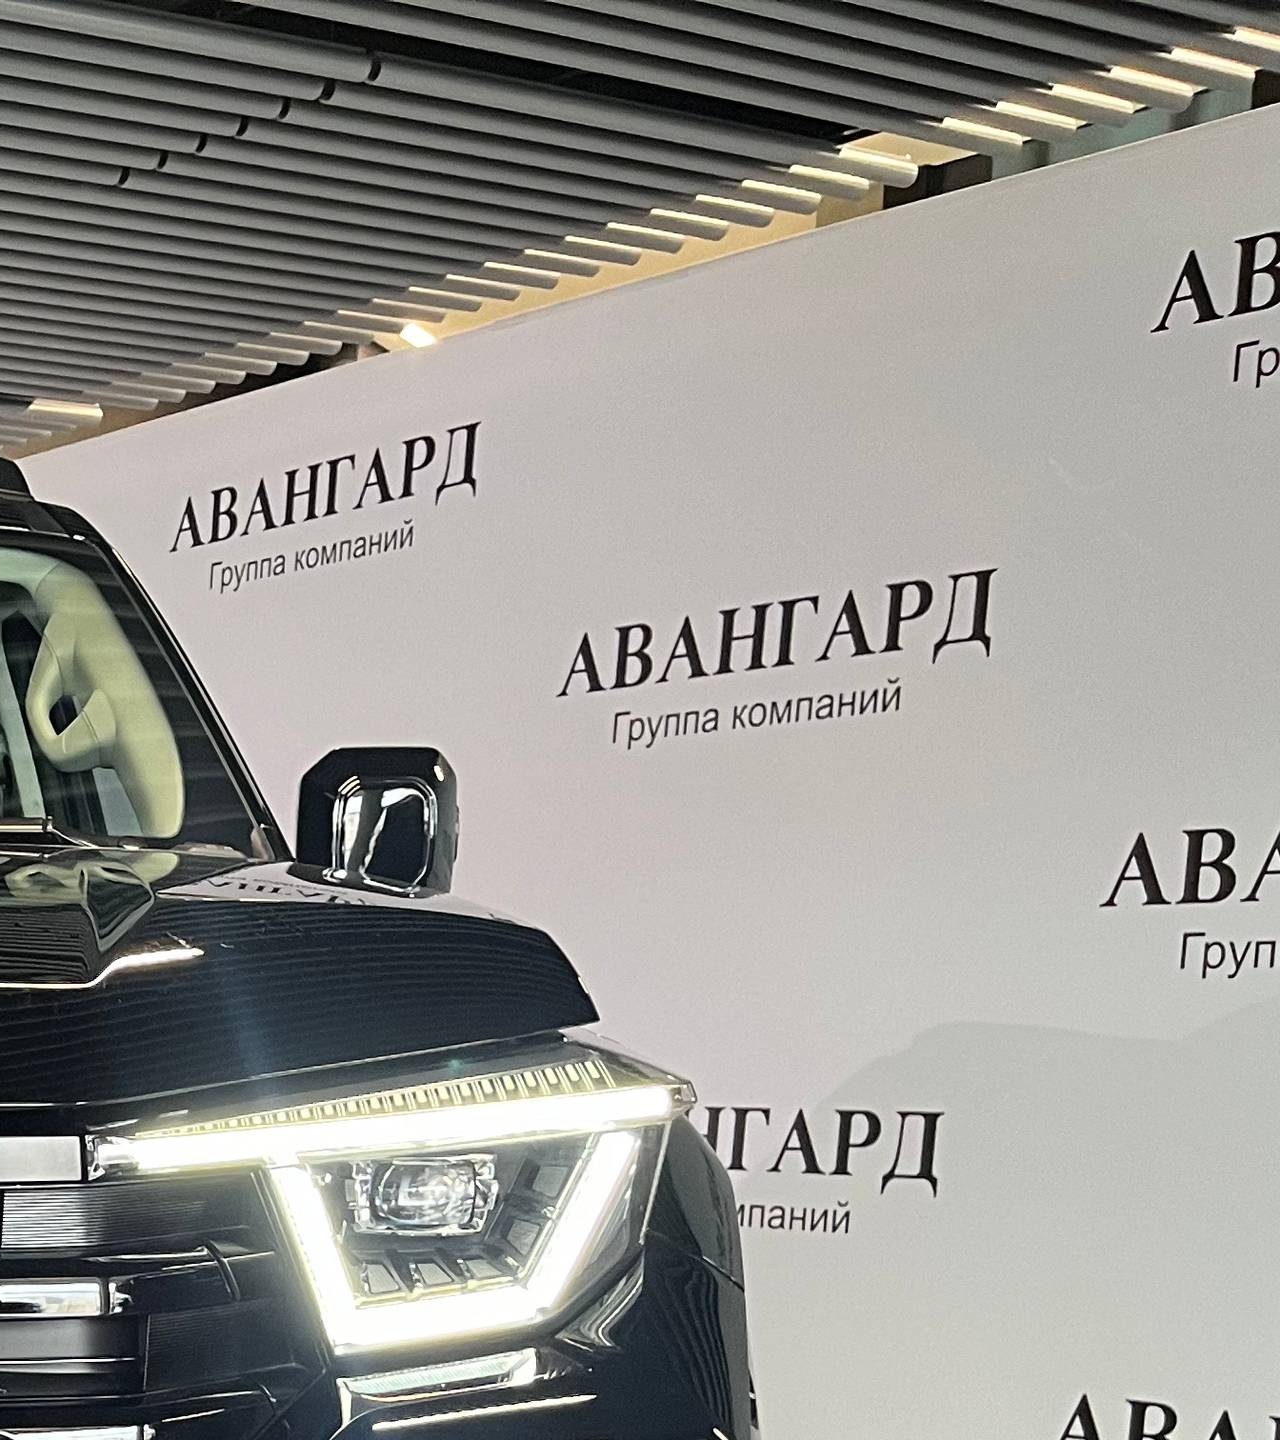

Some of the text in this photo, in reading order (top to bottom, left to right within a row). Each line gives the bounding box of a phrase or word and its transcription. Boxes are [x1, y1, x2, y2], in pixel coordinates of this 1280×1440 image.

[169, 421, 481, 553] АВАНГАРД
[209, 519, 415, 594] Группа компаний
[556, 568, 998, 697] АВАНГАРД
[612, 677, 902, 750] Группа компаний
